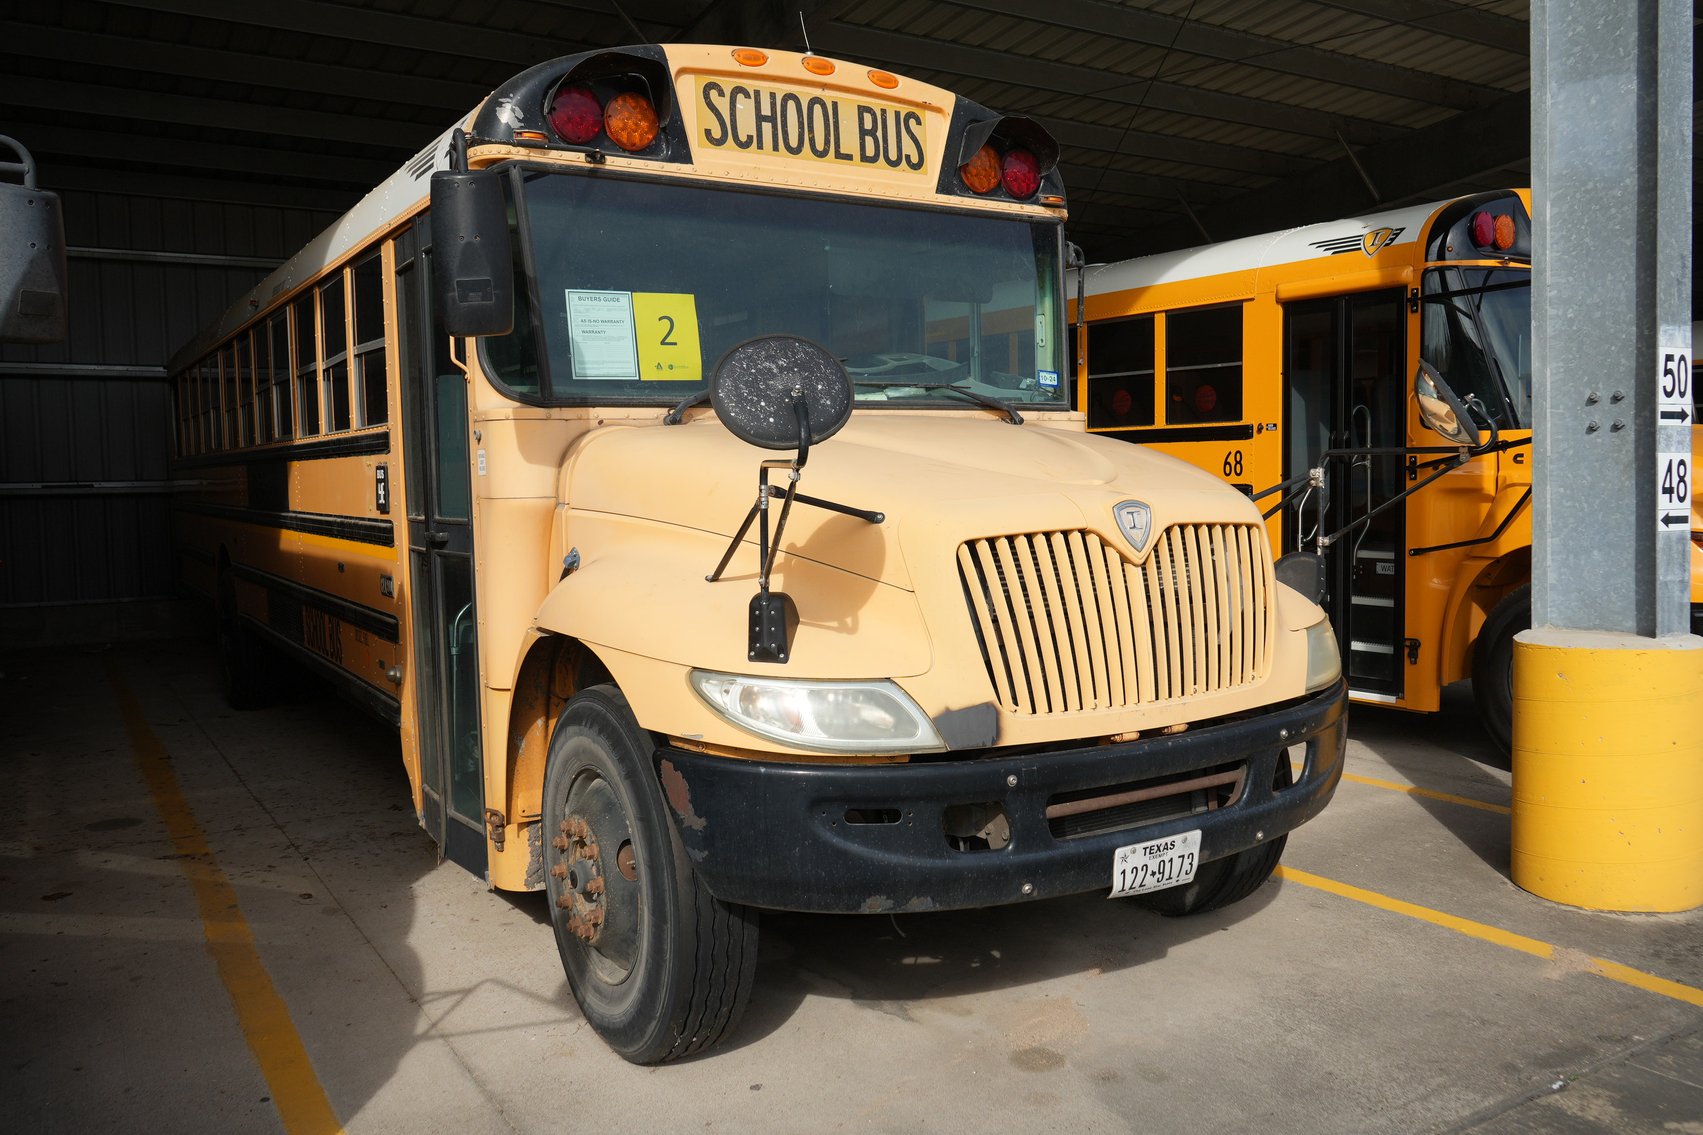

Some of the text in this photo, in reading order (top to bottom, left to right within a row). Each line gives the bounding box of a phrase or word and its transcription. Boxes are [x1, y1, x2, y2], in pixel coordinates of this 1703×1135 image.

[702, 81, 925, 171] SCHOOL BUS
[658, 315, 678, 346] 2
[1662, 354, 1688, 399] 50
[376, 469, 385, 479] BUS
[1223, 450, 1243, 476] 68
[1661, 458, 1688, 504] 48
[1142, 840, 1176, 857] TEXAS
[1148, 851, 1169, 861] EXEMPT
